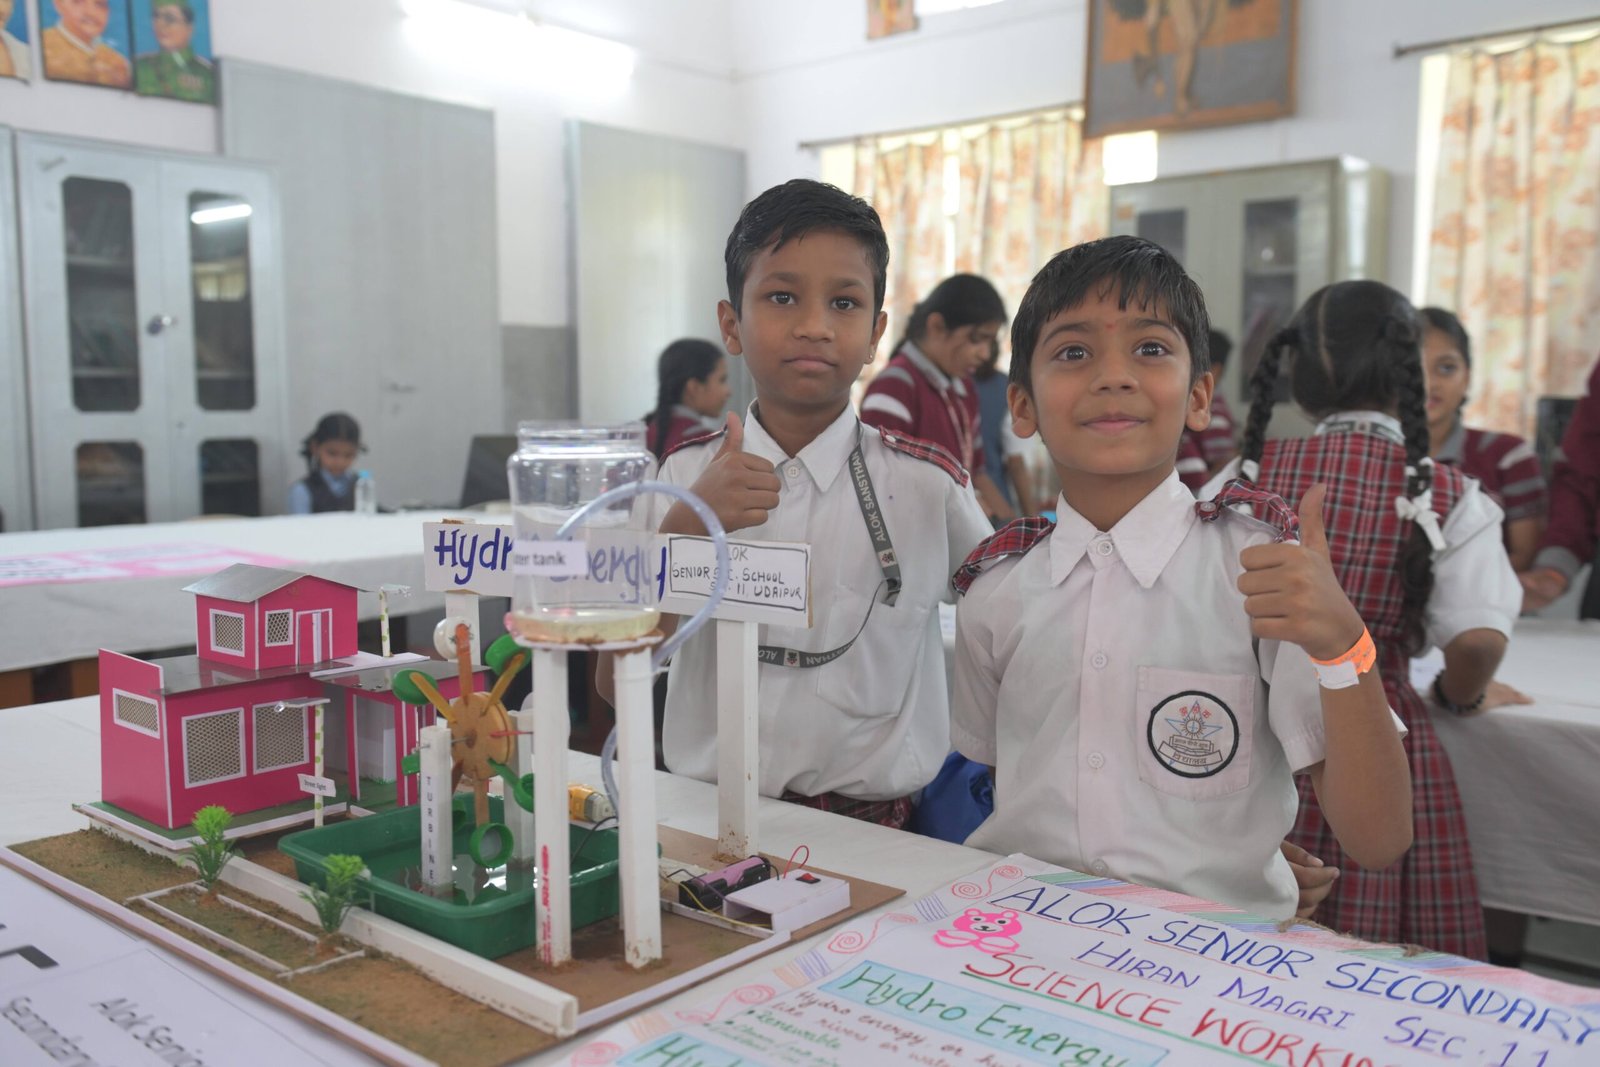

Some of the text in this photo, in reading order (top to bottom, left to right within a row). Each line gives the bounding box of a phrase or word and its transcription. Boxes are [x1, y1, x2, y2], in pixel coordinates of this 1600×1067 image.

[851, 451, 886, 542] ALOK SANSTHAN
[434, 528, 514, 585] Hydr
[671, 562, 711, 580] SENIOR
[742, 567, 785, 585] SCHOOL
[753, 585, 802, 600] UDAIPUR
[426, 775, 435, 880] TURBINE
[838, 965, 968, 1023] Hydro
[964, 952, 1183, 1028] SCIENCE
[990, 886, 1600, 1046] ALOK SENIOR SECONDARY
[1076, 941, 1200, 988] HIRAN
[1217, 977, 1355, 1028] MAGRI
